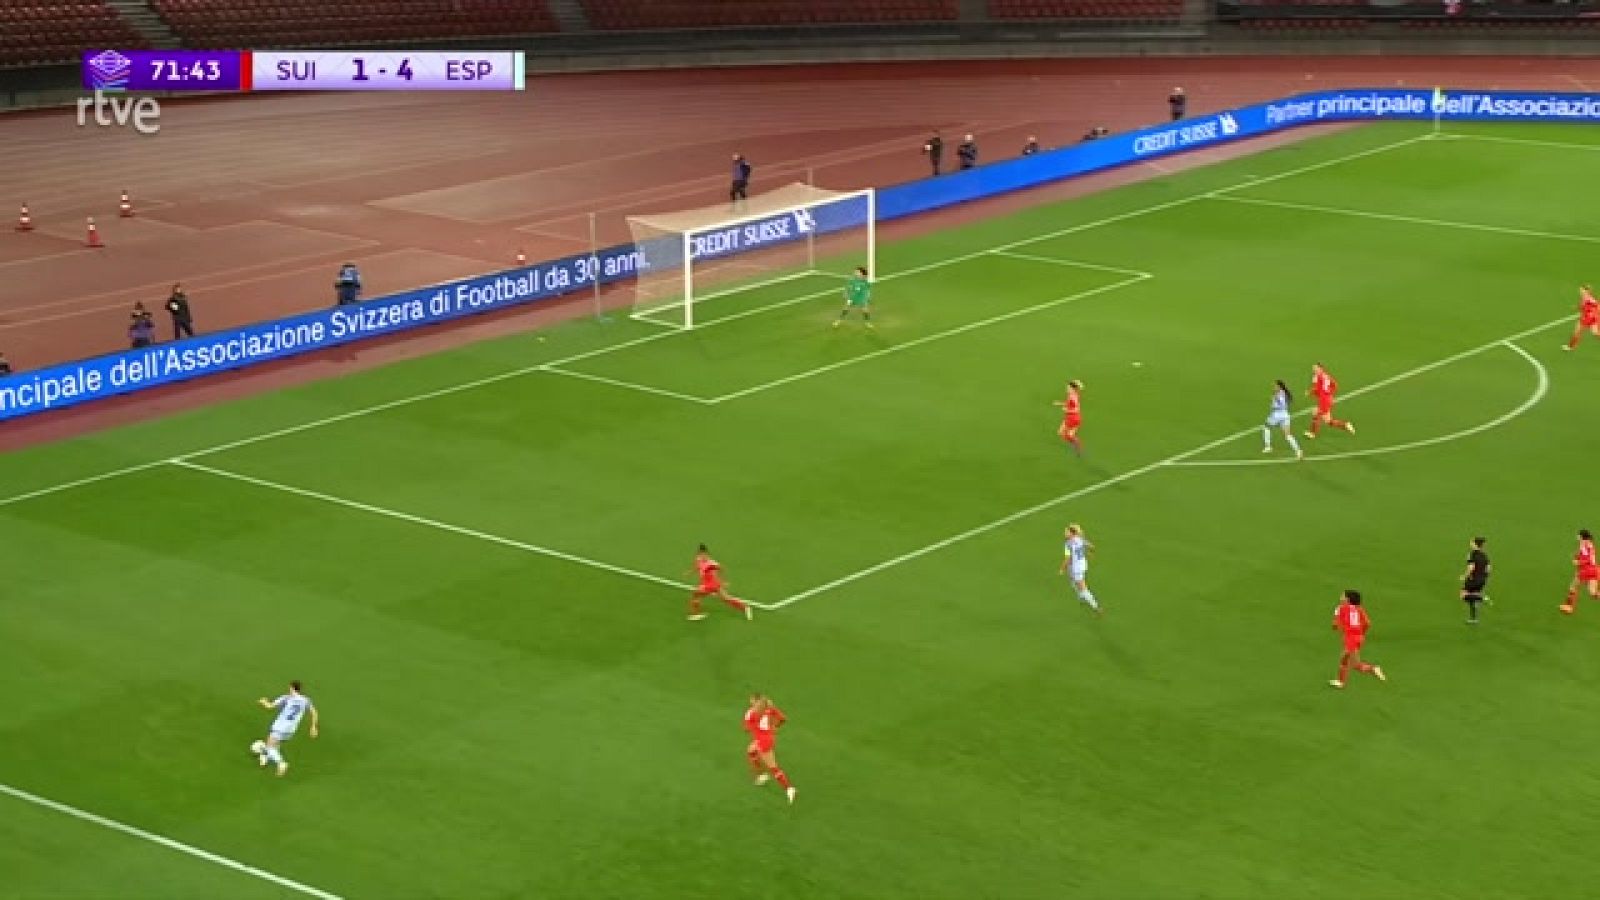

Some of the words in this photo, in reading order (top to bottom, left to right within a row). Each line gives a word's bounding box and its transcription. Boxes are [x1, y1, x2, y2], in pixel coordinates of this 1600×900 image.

[1317, 93, 1426, 118] principale
[1134, 130, 1176, 154] CREDIT
[1179, 120, 1217, 146] SUISSE
[744, 217, 791, 246] SUISSE
[109, 321, 324, 387] dell'Associazione
[330, 297, 424, 338] Svizzera
[430, 289, 451, 316] di
[457, 269, 541, 310] Football
[545, 263, 571, 291] da
[575, 256, 601, 281] 30
